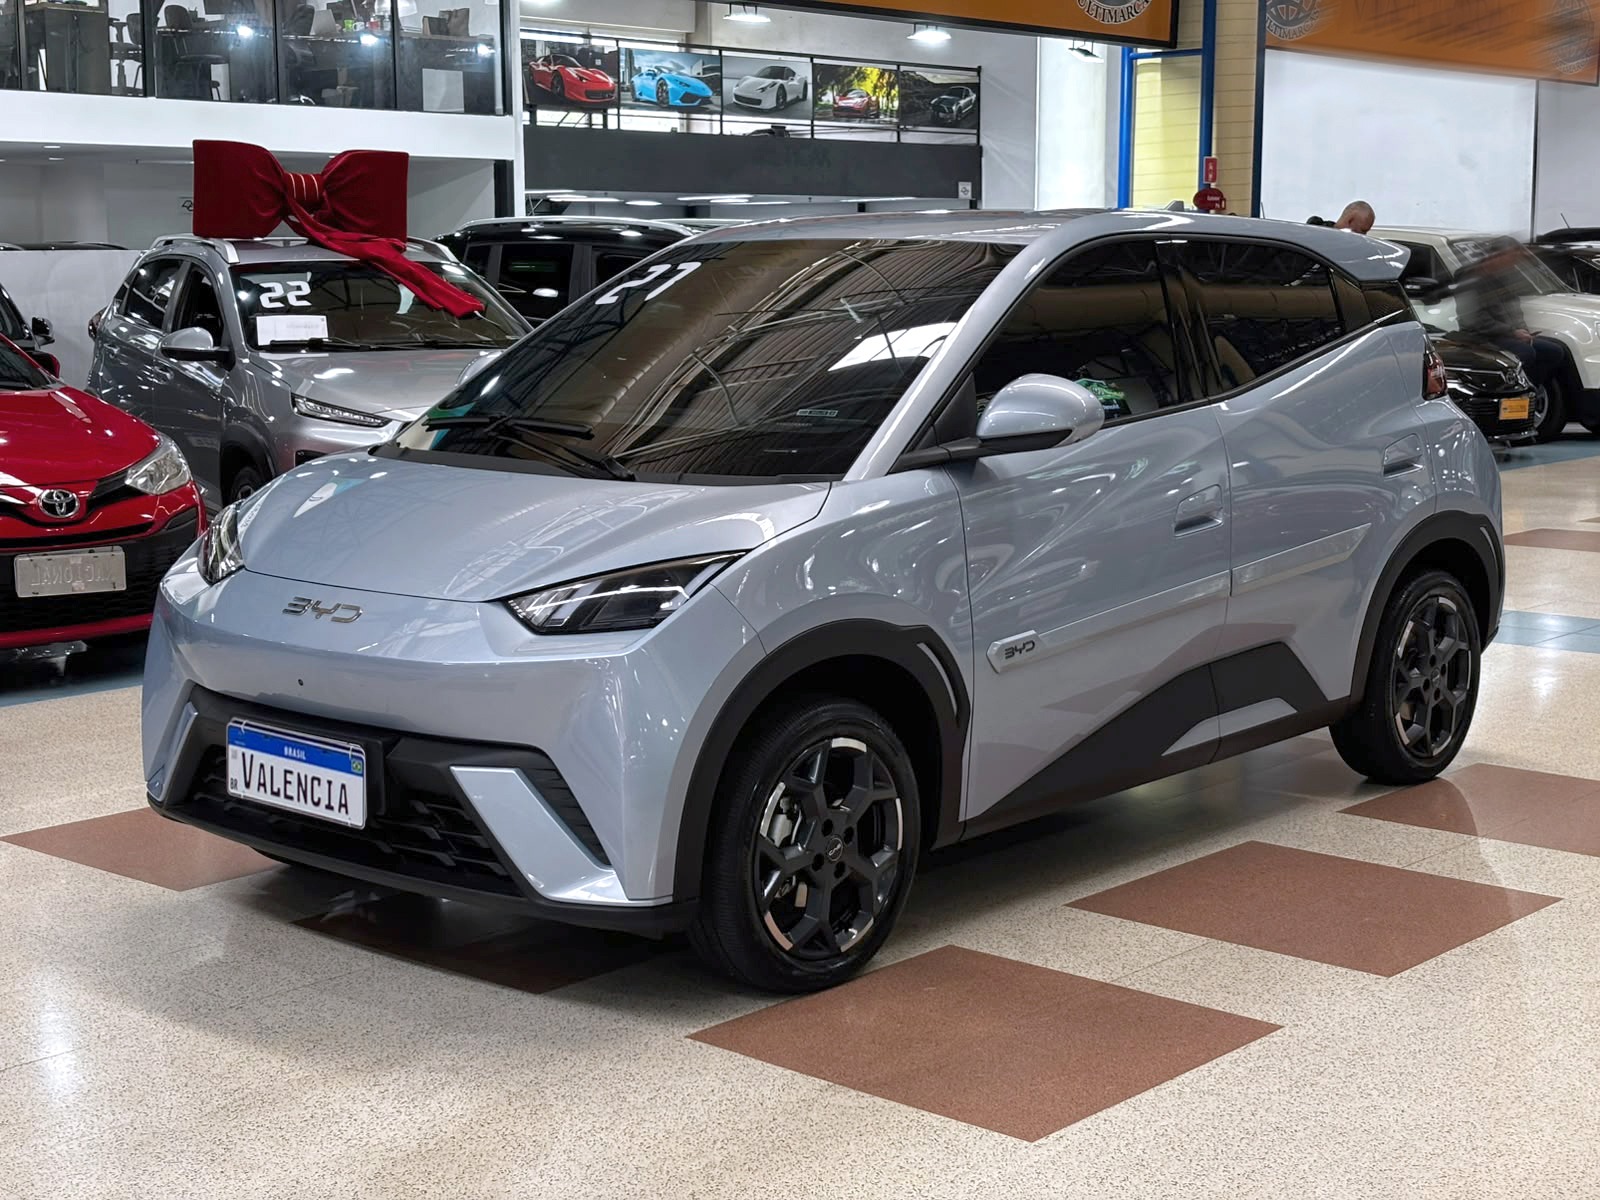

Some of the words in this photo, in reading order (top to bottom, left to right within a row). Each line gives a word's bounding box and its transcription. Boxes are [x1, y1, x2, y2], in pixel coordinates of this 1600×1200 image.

[282, 596, 363, 624] BYD
[1004, 640, 1036, 660] BYD
[283, 745, 307, 760] BRASIL
[230, 777, 238, 790] BR
[241, 751, 349, 815] VALENCIA
